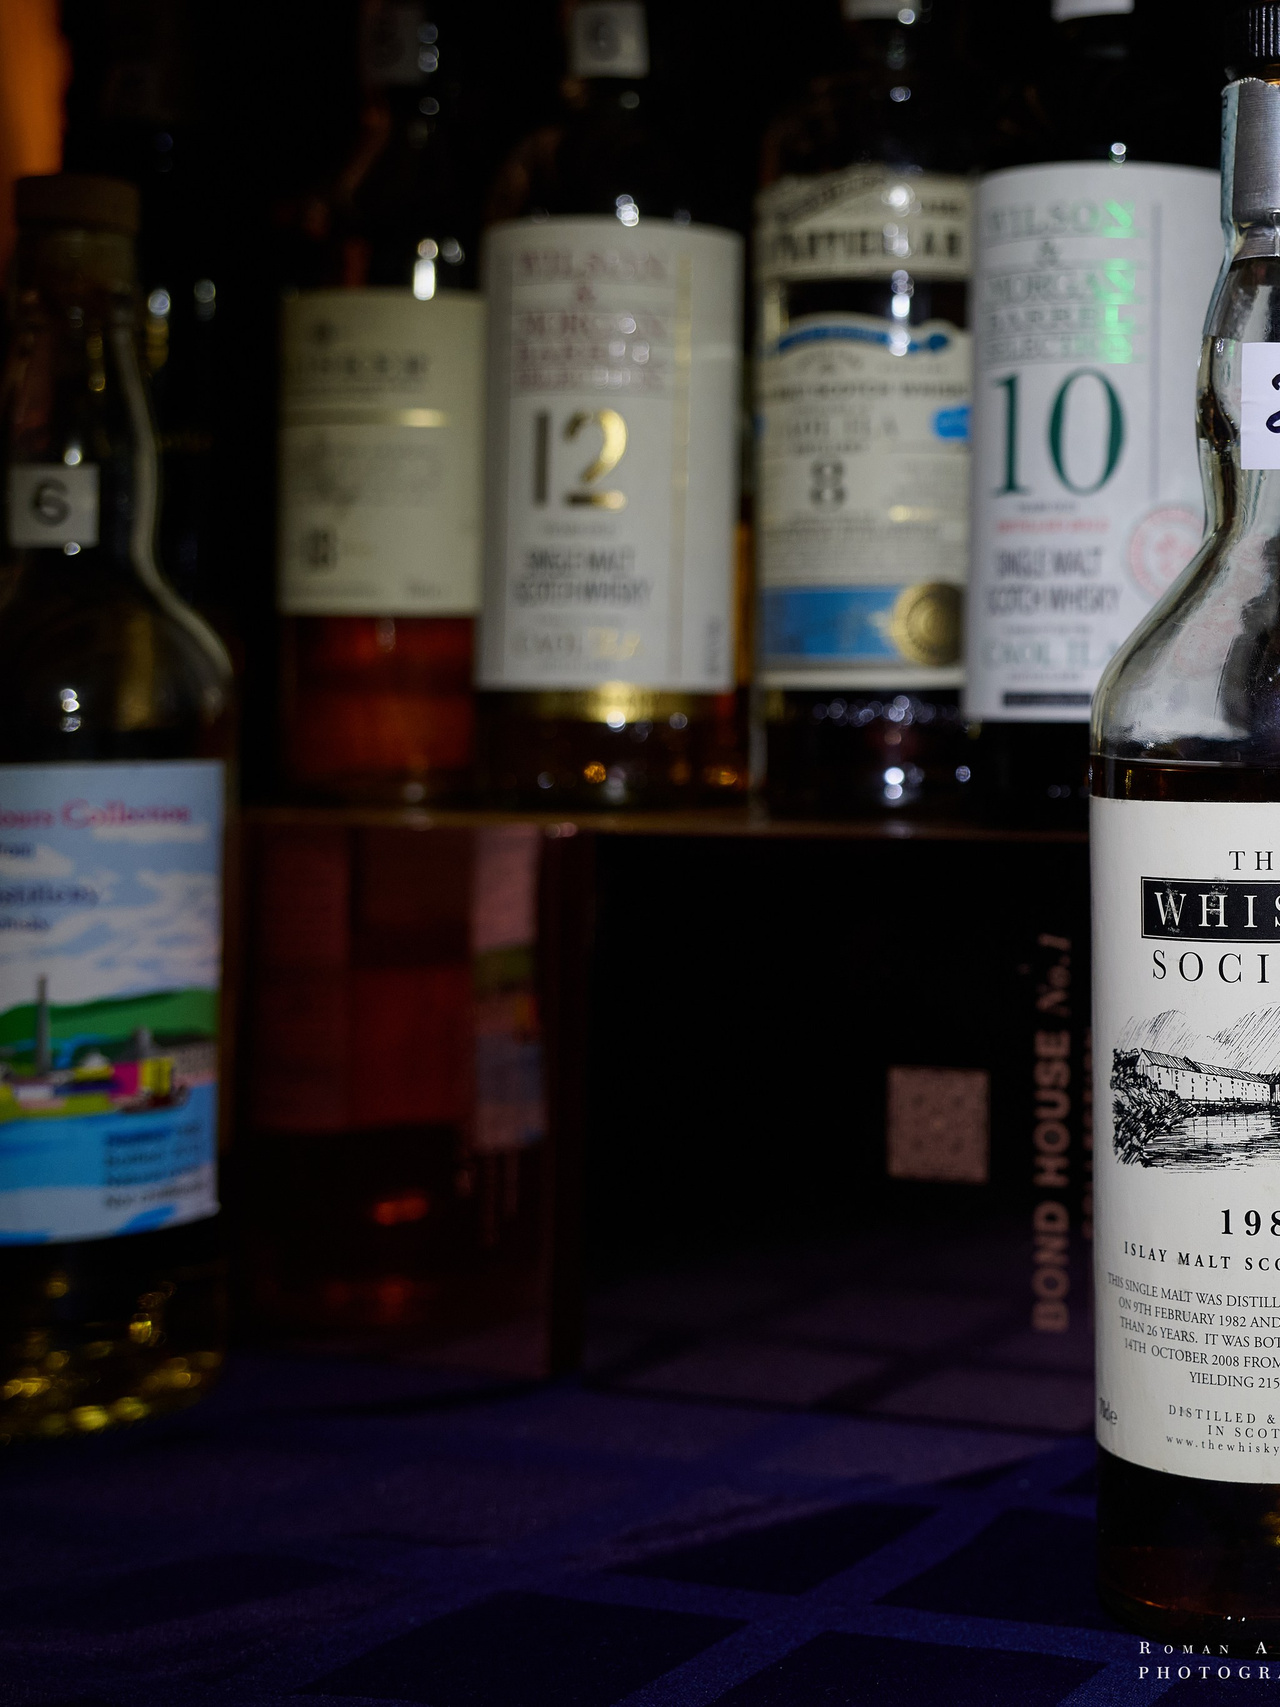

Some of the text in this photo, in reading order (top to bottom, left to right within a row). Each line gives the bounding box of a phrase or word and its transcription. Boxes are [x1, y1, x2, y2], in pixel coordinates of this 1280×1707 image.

[993, 366, 1128, 498] 10
[533, 406, 629, 510] 12
[31, 477, 71, 527] 6
[1032, 1029, 1072, 1188] HOUSE
[1032, 1201, 1071, 1333] BOND
[1124, 1241, 1168, 1263] ISLAY
[1178, 1251, 1231, 1269] MALT
[1107, 1271, 1124, 1289] THIS
[1125, 1278, 1158, 1298] SINGLE
[1161, 1287, 1193, 1303] MALT
[1196, 1292, 1223, 1306] WAS
[1118, 1296, 1132, 1310] ON
[1133, 1301, 1152, 1317] 9TH
[1154, 1306, 1216, 1326] FEBRUARY
[1219, 1315, 1246, 1328] 1982
[1120, 1316, 1145, 1334] THAN
[1147, 1325, 1158, 1337] 26
[1160, 1326, 1198, 1344] YEARS.
[1204, 1333, 1219, 1345] IT
[1222, 1334, 1250, 1348] WAS
[1124, 1337, 1147, 1354] 14TH
[1151, 1344, 1209, 1365] OCTOBER
[1211, 1354, 1240, 1367] 2008
[1189, 1371, 1255, 1389] YIELDING
[1258, 1377, 1280, 1390] 215
[1168, 1404, 1257, 1425] DISTILLED
[1266, 1414, 1276, 1425] &
[1207, 1424, 1225, 1436] IN
